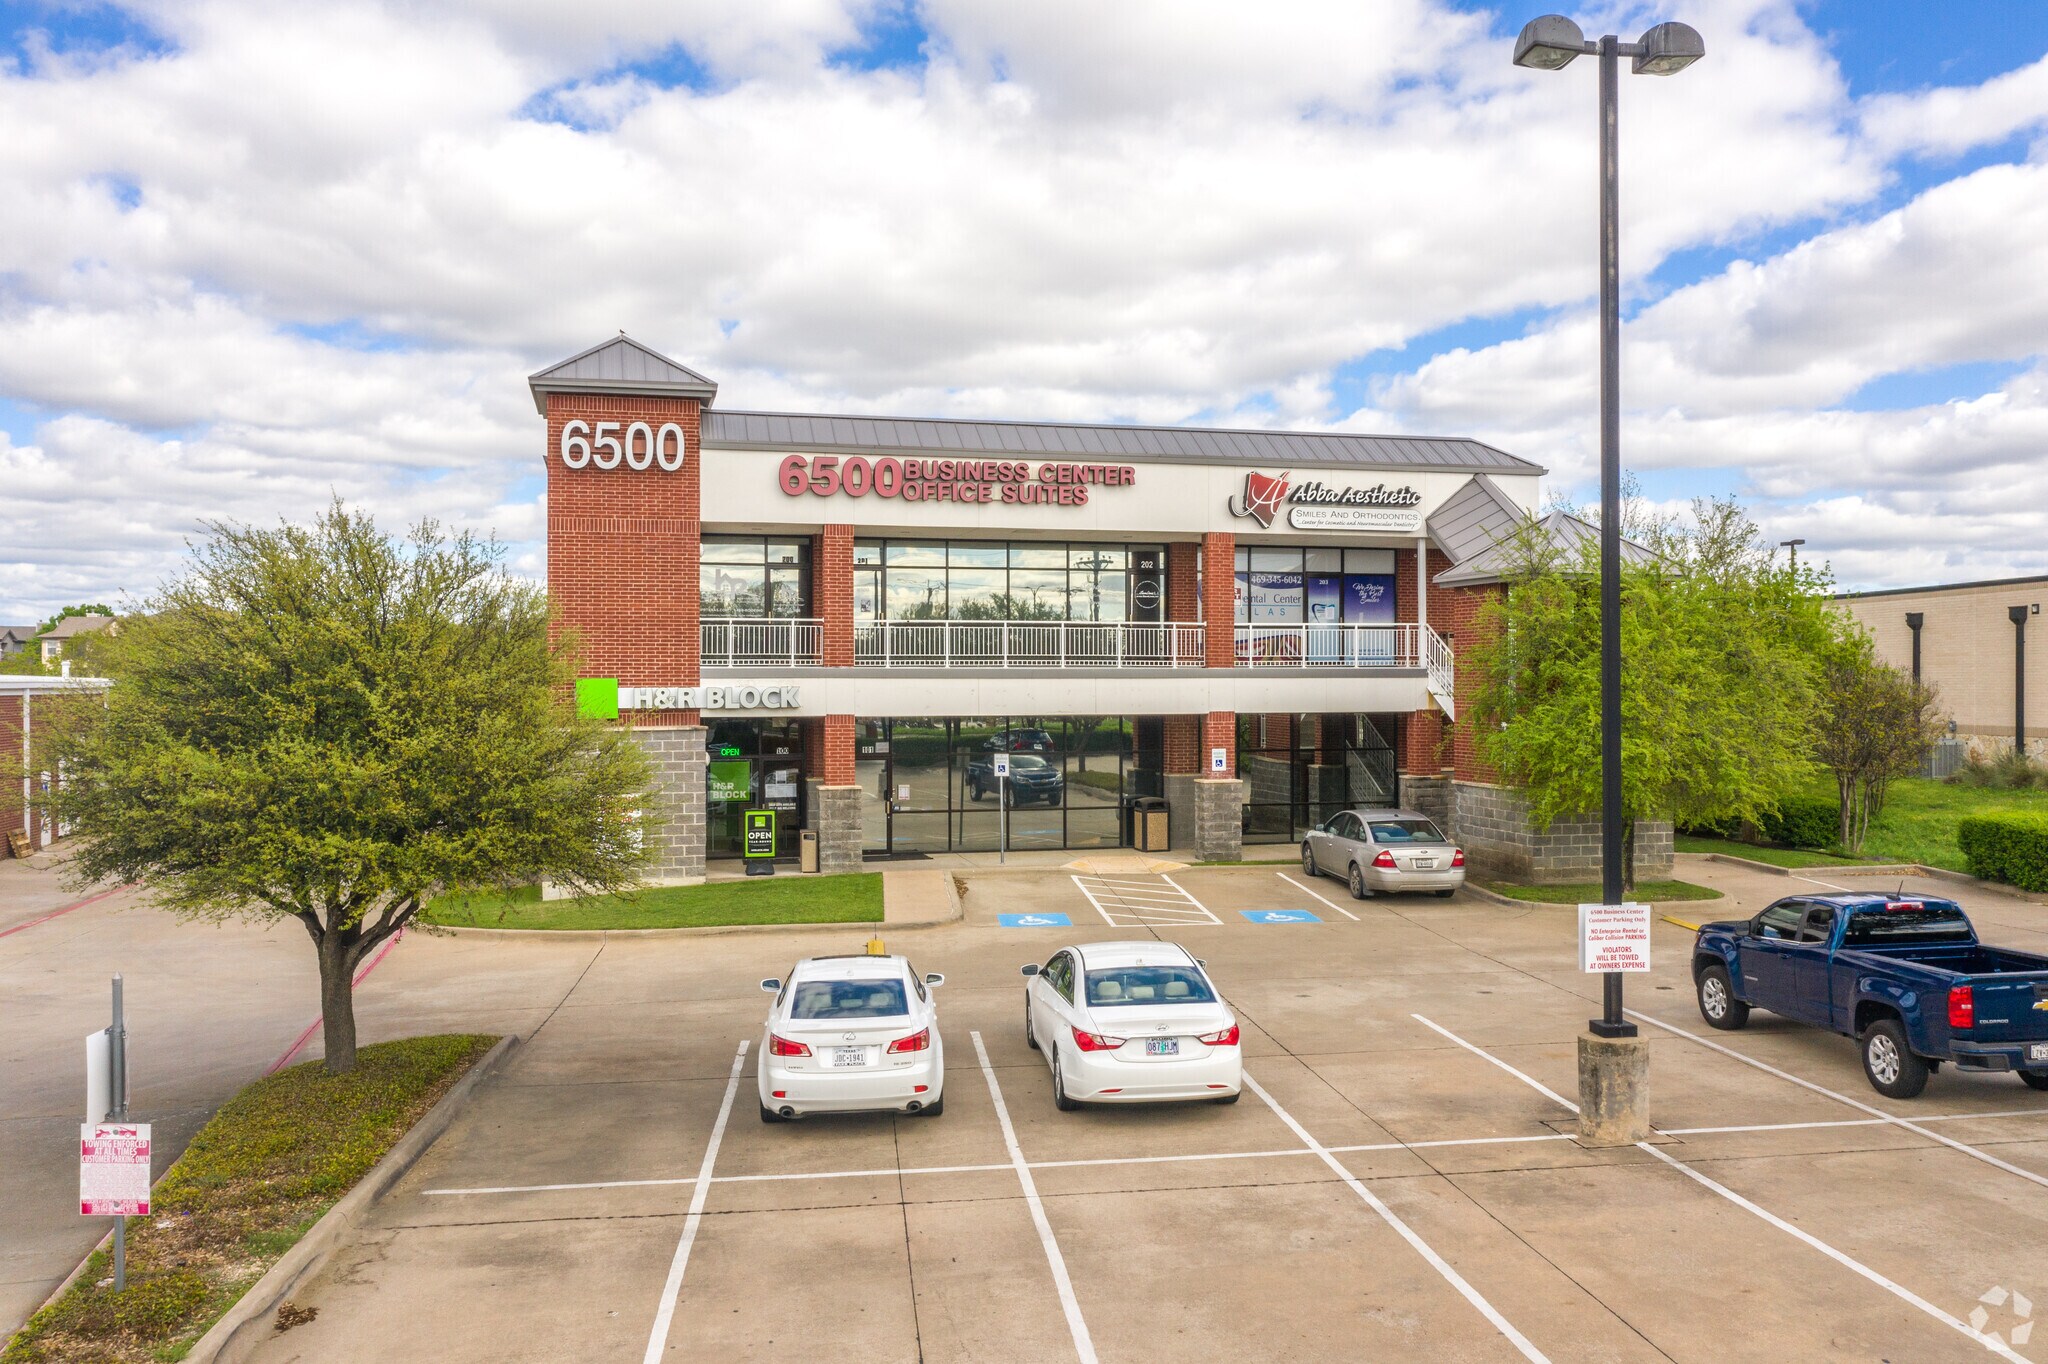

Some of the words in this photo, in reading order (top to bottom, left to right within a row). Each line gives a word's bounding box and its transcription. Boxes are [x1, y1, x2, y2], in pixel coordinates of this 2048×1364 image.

[561, 419, 685, 472] 6500
[779, 455, 904, 498] 6500
[903, 460, 1030, 483] BUSINESS
[1038, 463, 1136, 486] CENTER
[902, 482, 994, 503] OFFICE
[1001, 484, 1089, 506] SUITES
[1290, 482, 1340, 503] Abba
[1341, 484, 1421, 505] Aesthetic
[1140, 561, 1154, 569] 202
[1243, 593, 1266, 604] ental
[1273, 593, 1302, 604] Center
[634, 686, 697, 709] H&R
[706, 686, 801, 710] BLOCK
[721, 748, 740, 756] OPEN
[712, 782, 735, 790] H&R
[712, 791, 747, 799] BLOCK
[85, 1140, 112, 1148] TOWING
[113, 1140, 147, 1148] ENFORCED
[82, 1155, 111, 1163] CUSTOMER
[111, 1155, 135, 1163] PARKING
